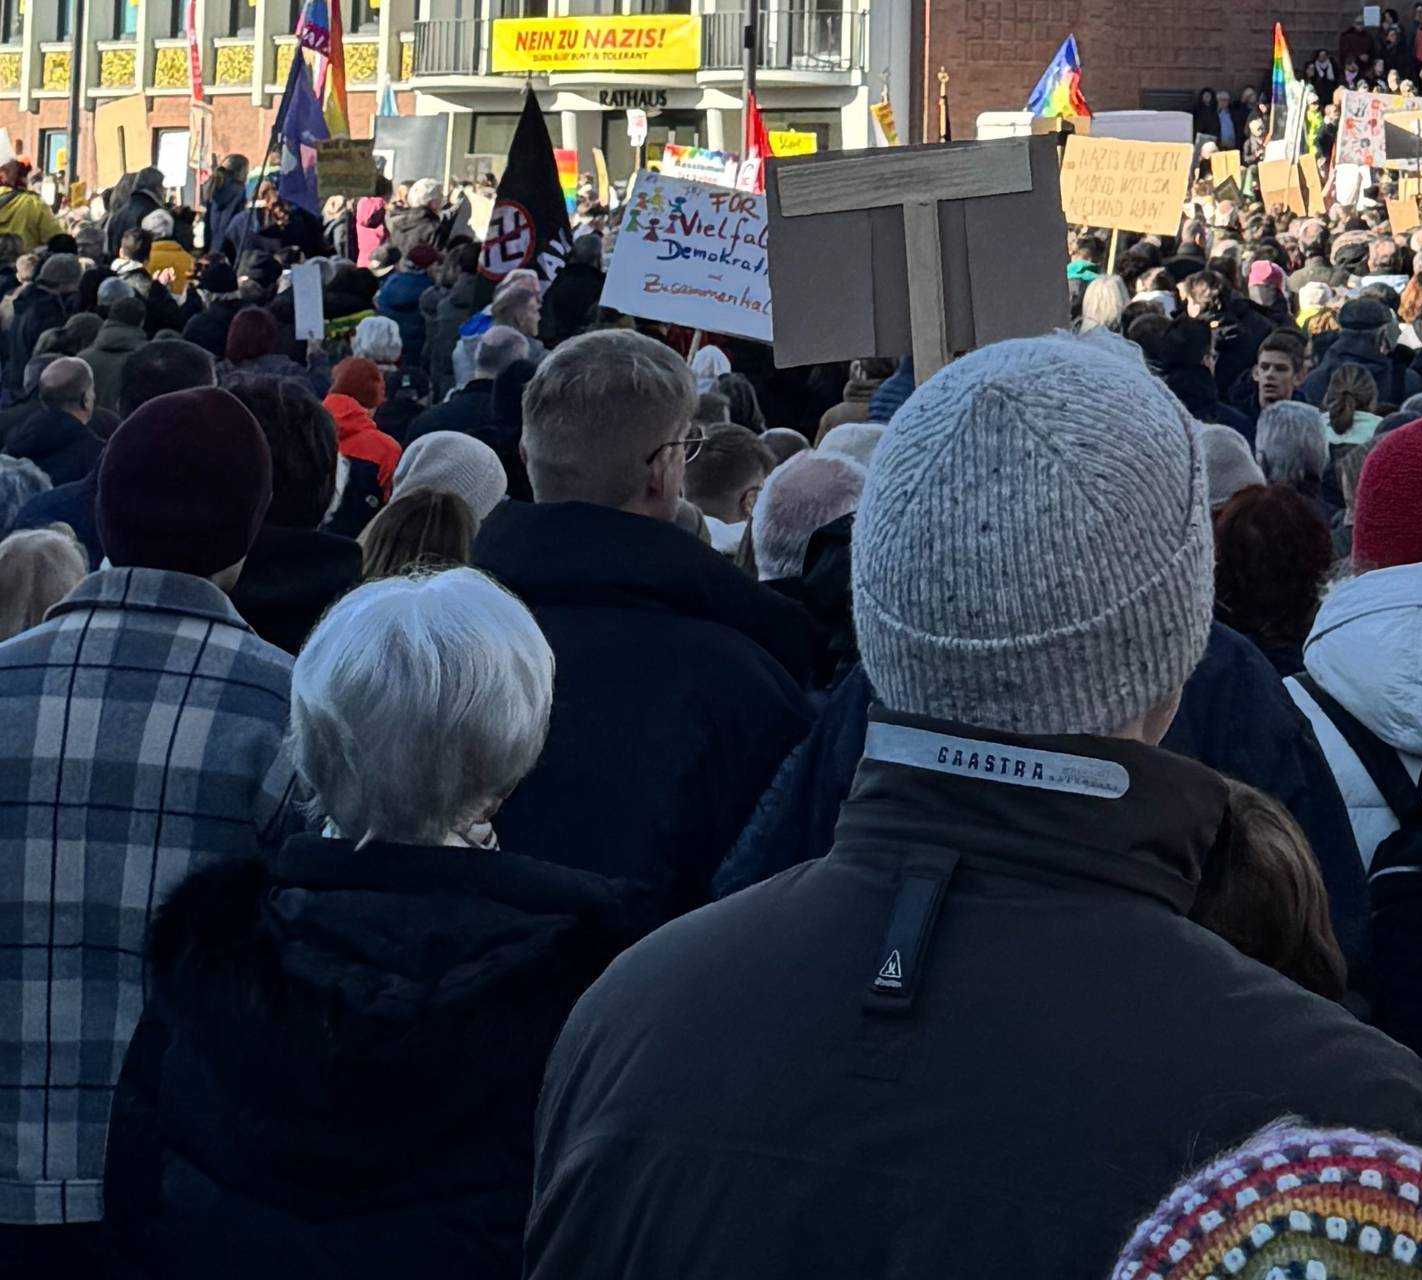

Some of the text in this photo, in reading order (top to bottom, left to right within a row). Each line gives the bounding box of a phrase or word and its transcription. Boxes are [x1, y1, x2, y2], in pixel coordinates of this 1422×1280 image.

[515, 27, 667, 51] NEIN ZU NAZIS!
[602, 51, 648, 61] TOLERANT
[600, 90, 668, 107] RATHAUS
[937, 746, 1043, 780] GAASTRA
